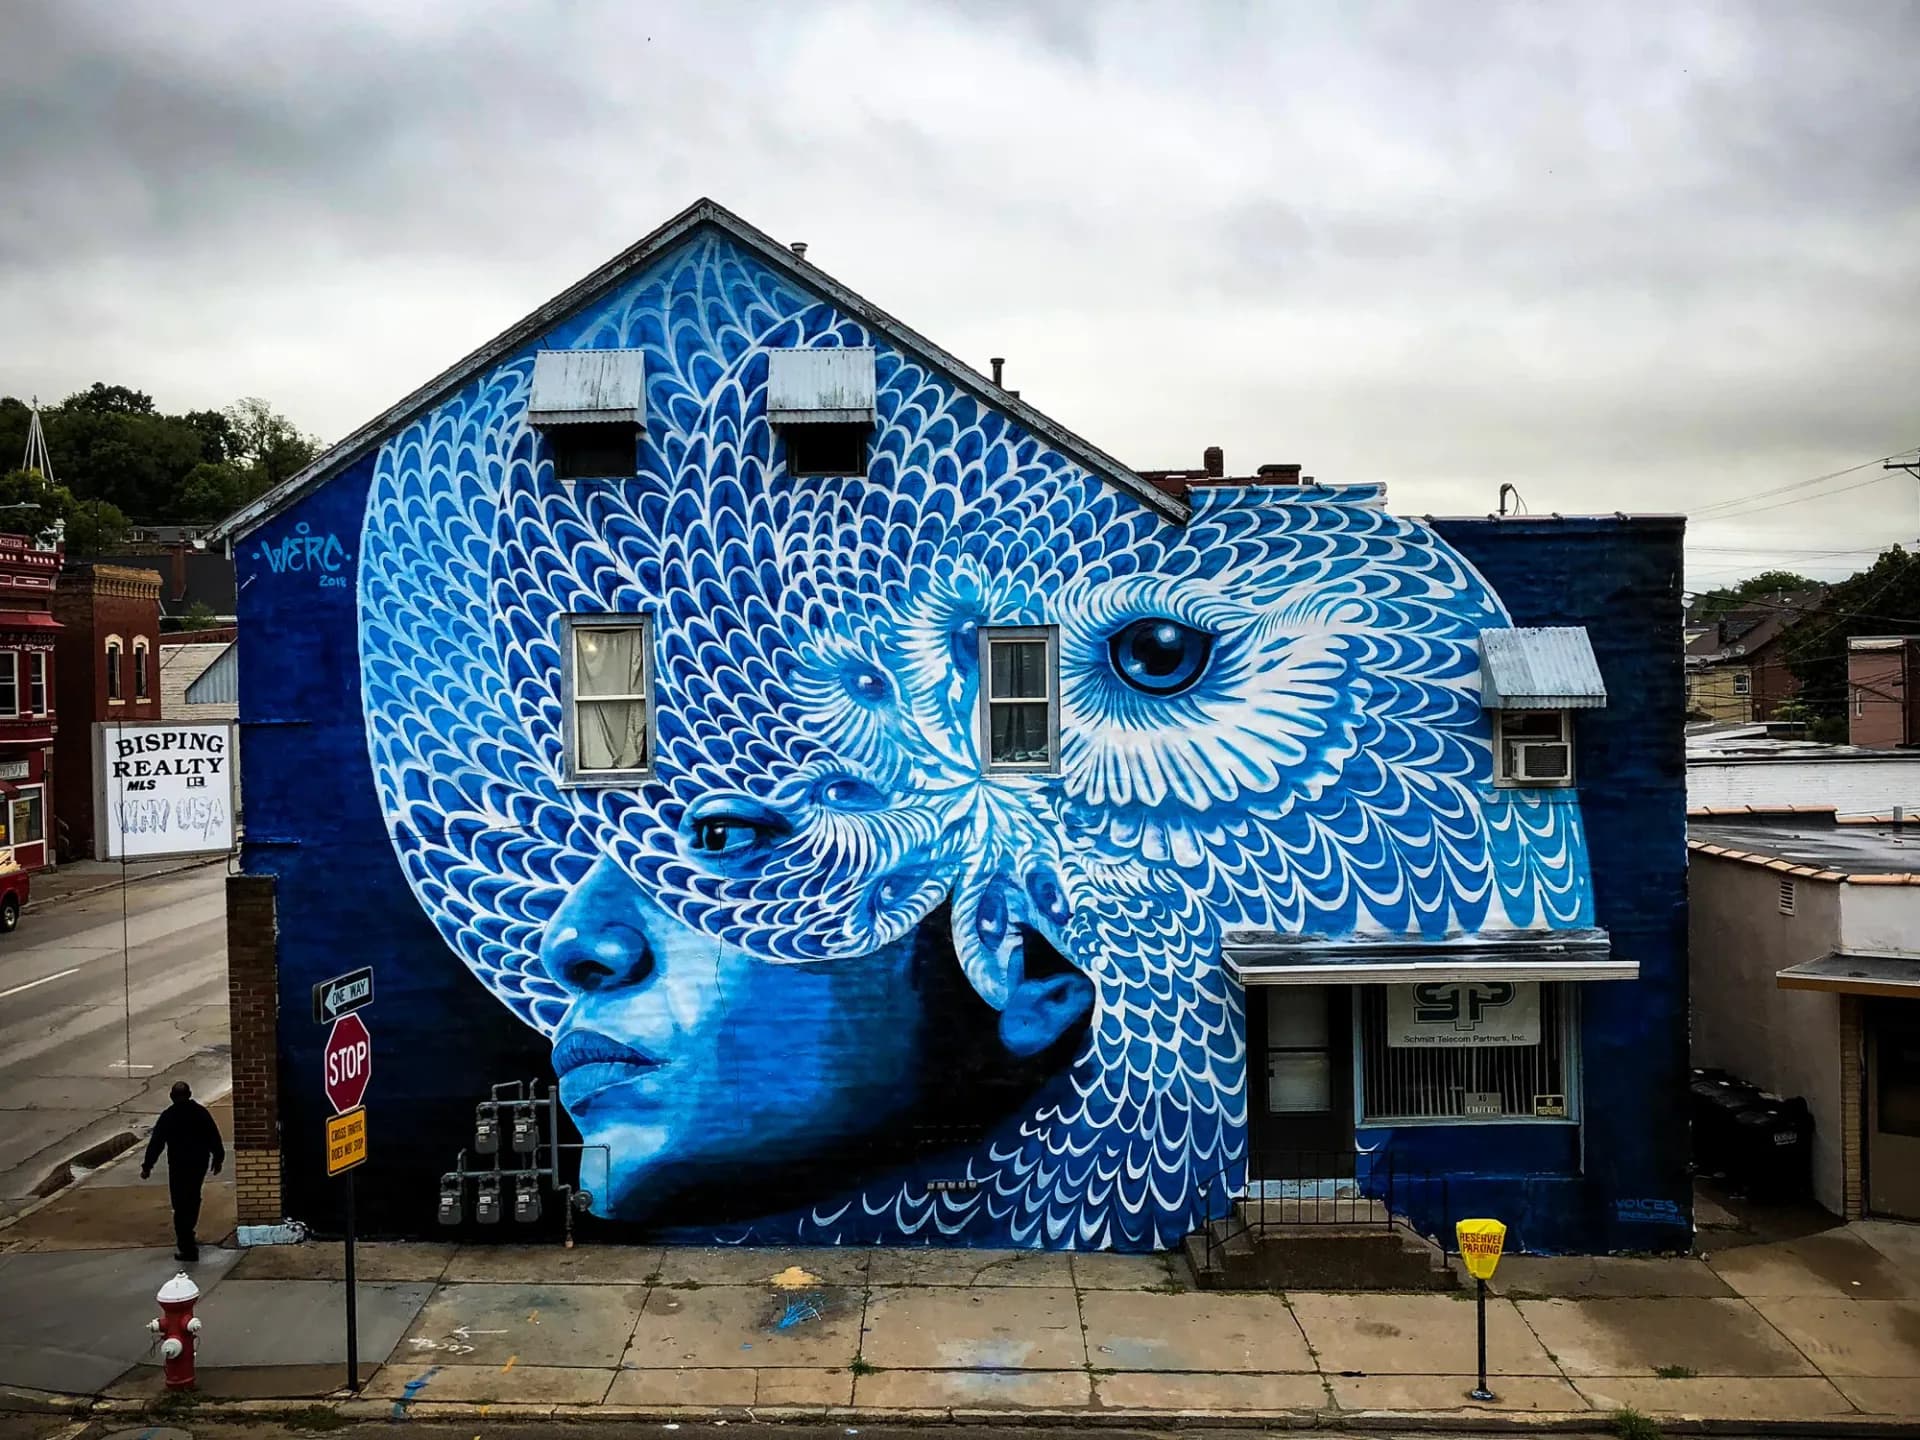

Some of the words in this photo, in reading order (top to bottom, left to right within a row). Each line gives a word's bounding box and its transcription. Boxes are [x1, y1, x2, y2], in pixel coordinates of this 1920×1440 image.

[116, 732, 224, 758] BISPING
[112, 757, 224, 778] REALTY
[127, 779, 156, 791] MLS
[332, 988, 345, 1006] ONE
[350, 980, 366, 999] WAY
[1404, 1034, 1435, 1043] Schmitt
[1438, 1034, 1471, 1043] Telecom
[1511, 1033, 1527, 1042] Inc.
[329, 1041, 367, 1087] STOP
[1463, 1243, 1500, 1255] PARKING
